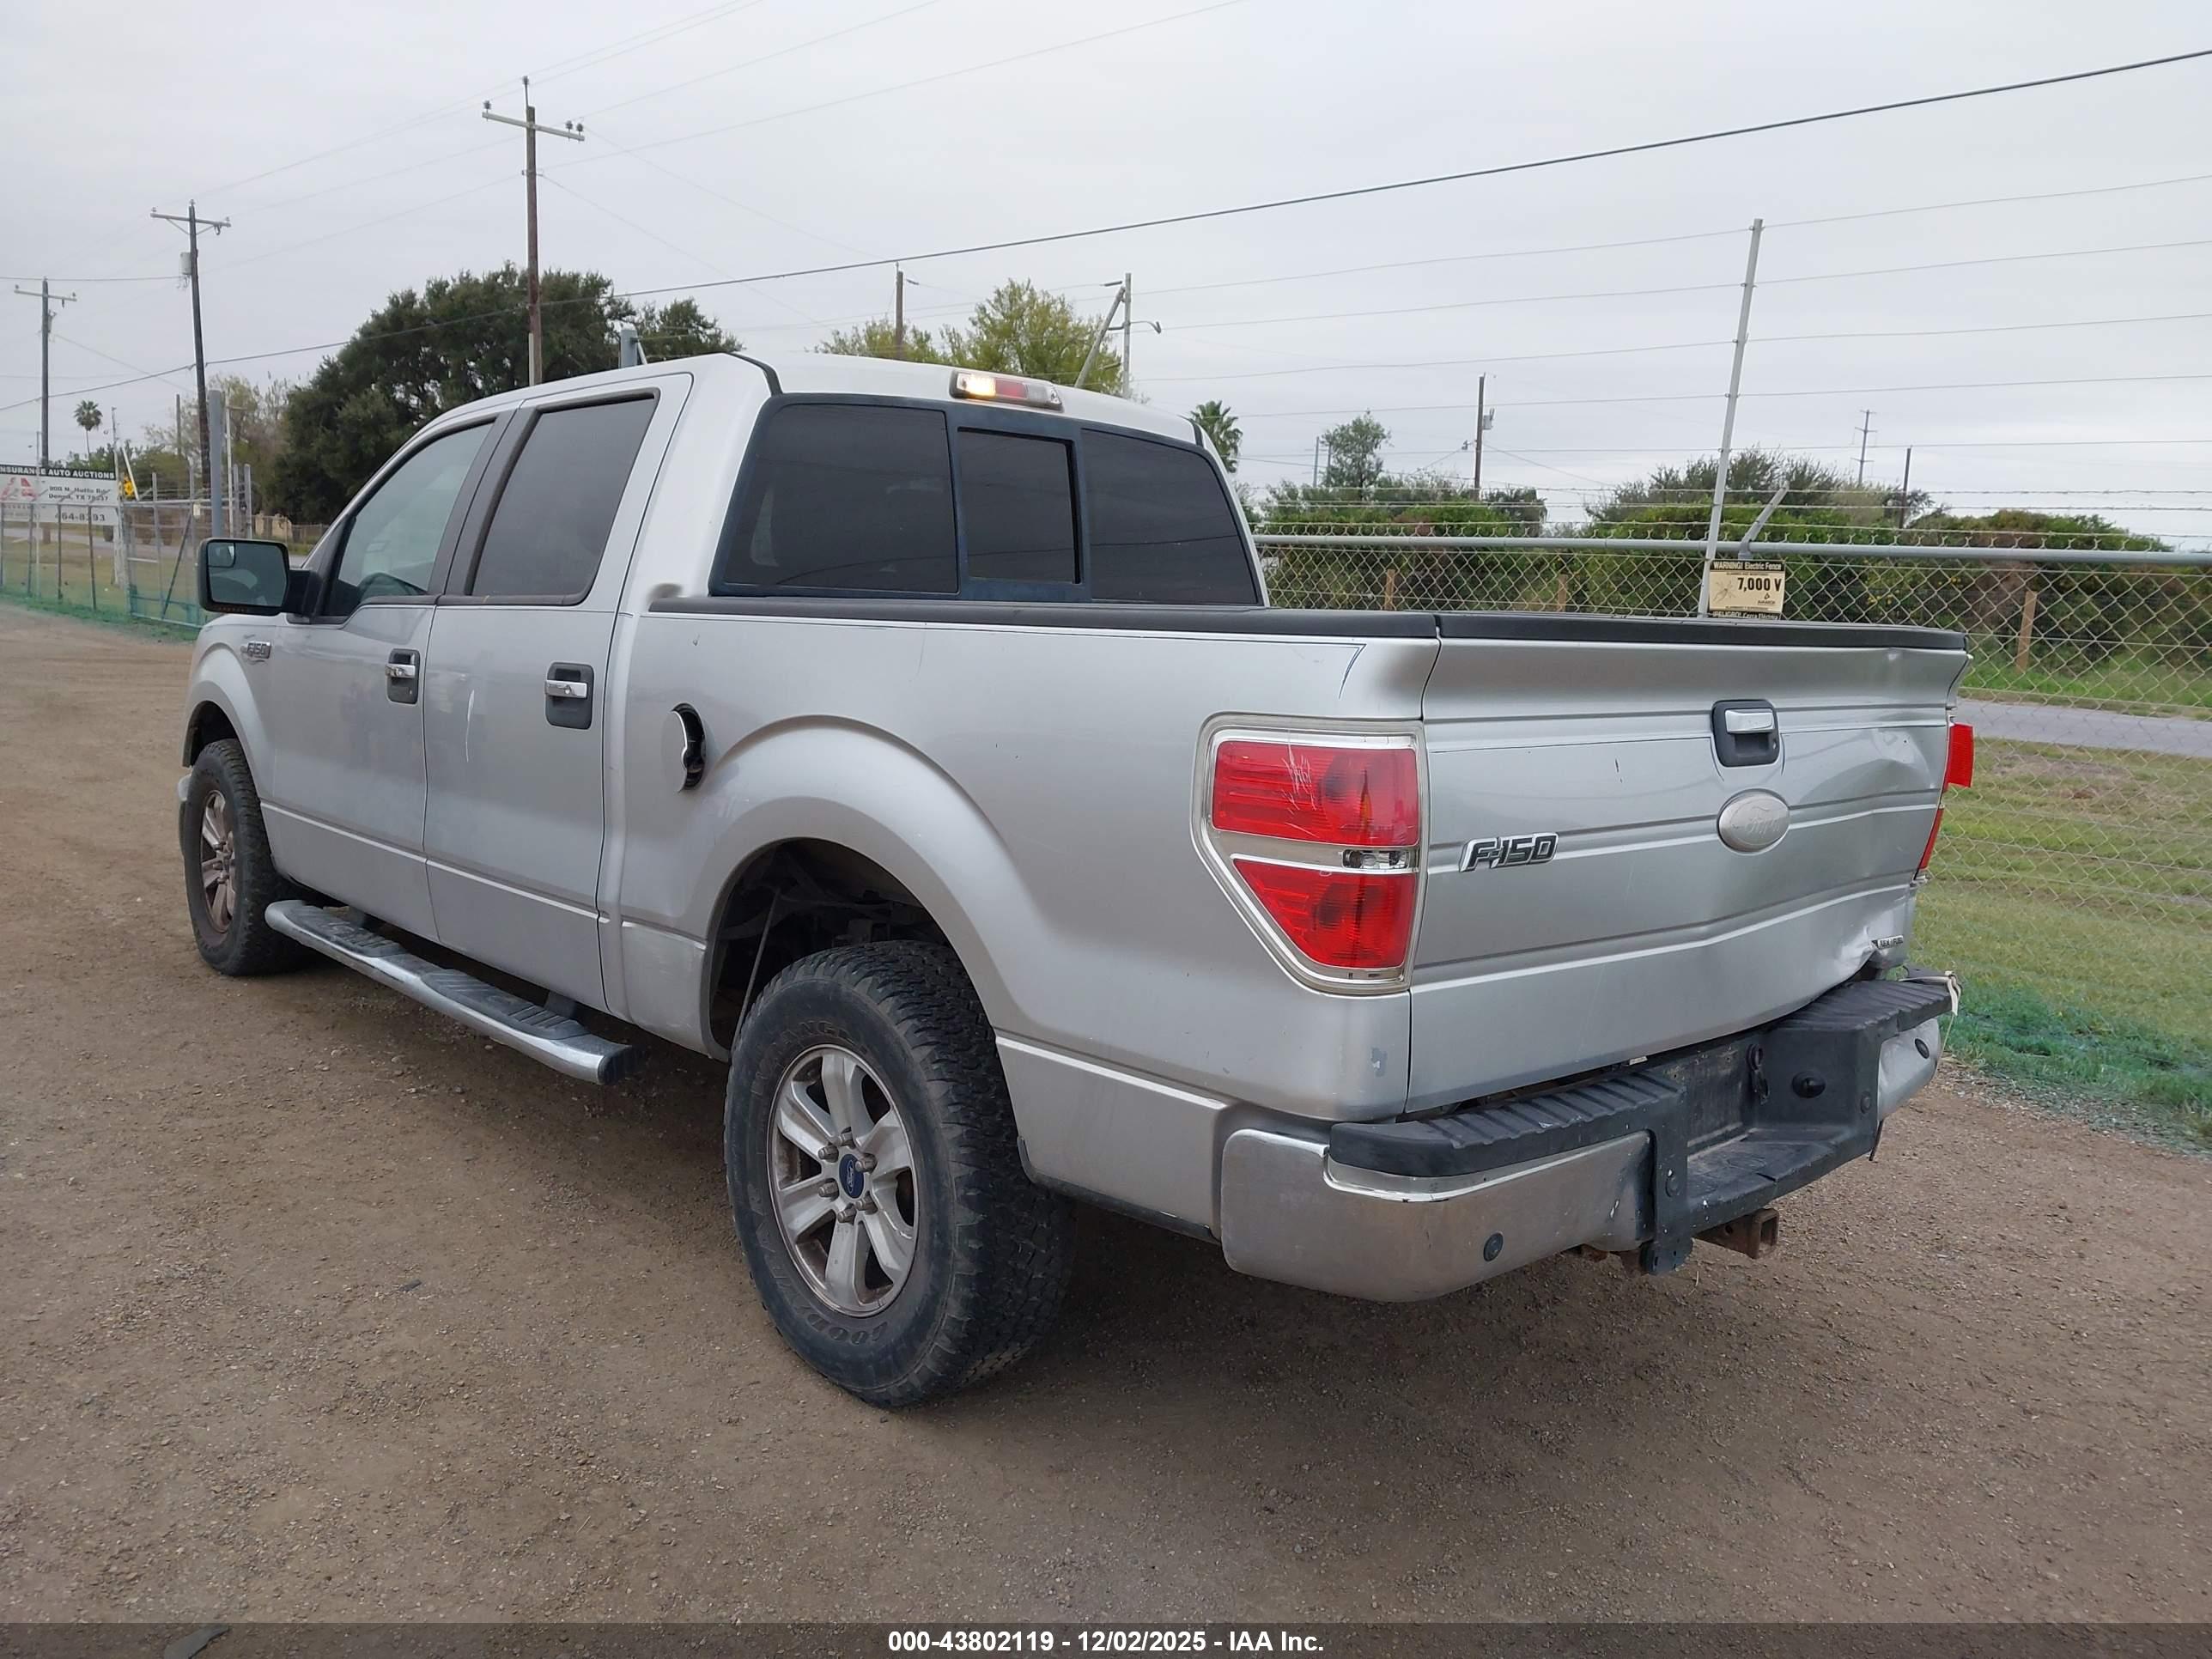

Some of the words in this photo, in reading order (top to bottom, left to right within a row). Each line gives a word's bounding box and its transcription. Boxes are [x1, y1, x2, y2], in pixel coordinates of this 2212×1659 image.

[48, 468, 71, 477] AUTO
[72, 470, 115, 479] AUCTIONS
[1713, 561, 1743, 570] WARNING!
[1745, 562, 1765, 570] Electric
[1765, 562, 1782, 571] Fence
[1737, 577, 1771, 592] 7,000
[1774, 578, 1782, 592] V
[1459, 832, 1559, 872] F-150
